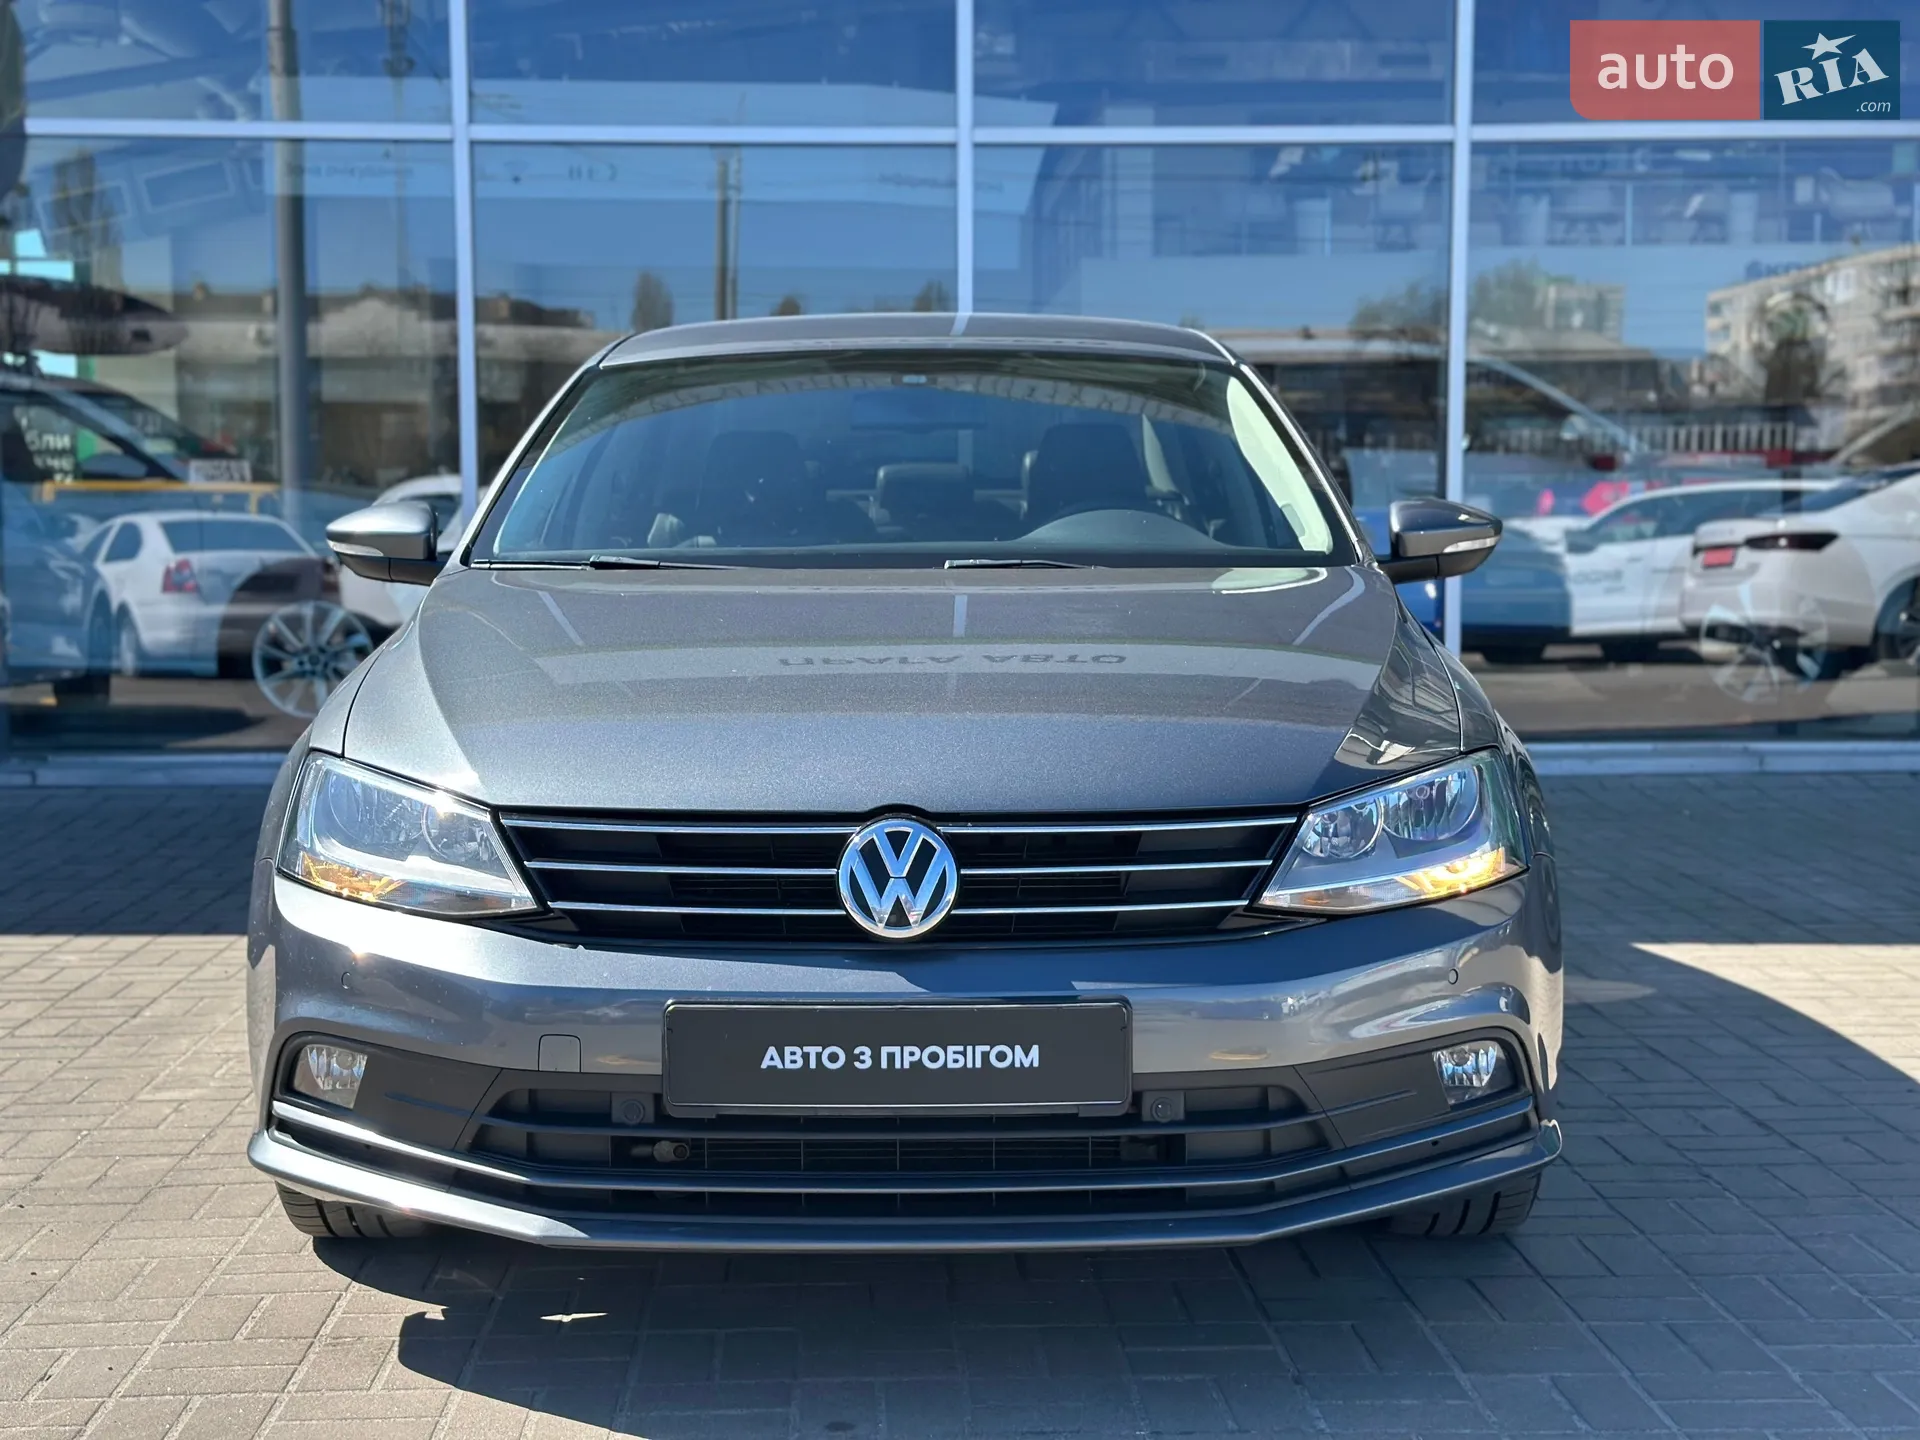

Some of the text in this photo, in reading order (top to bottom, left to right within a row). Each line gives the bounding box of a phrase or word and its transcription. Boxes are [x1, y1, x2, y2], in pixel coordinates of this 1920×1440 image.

[760, 1044, 1040, 1070] АВТО З ПРОБІГОМ
